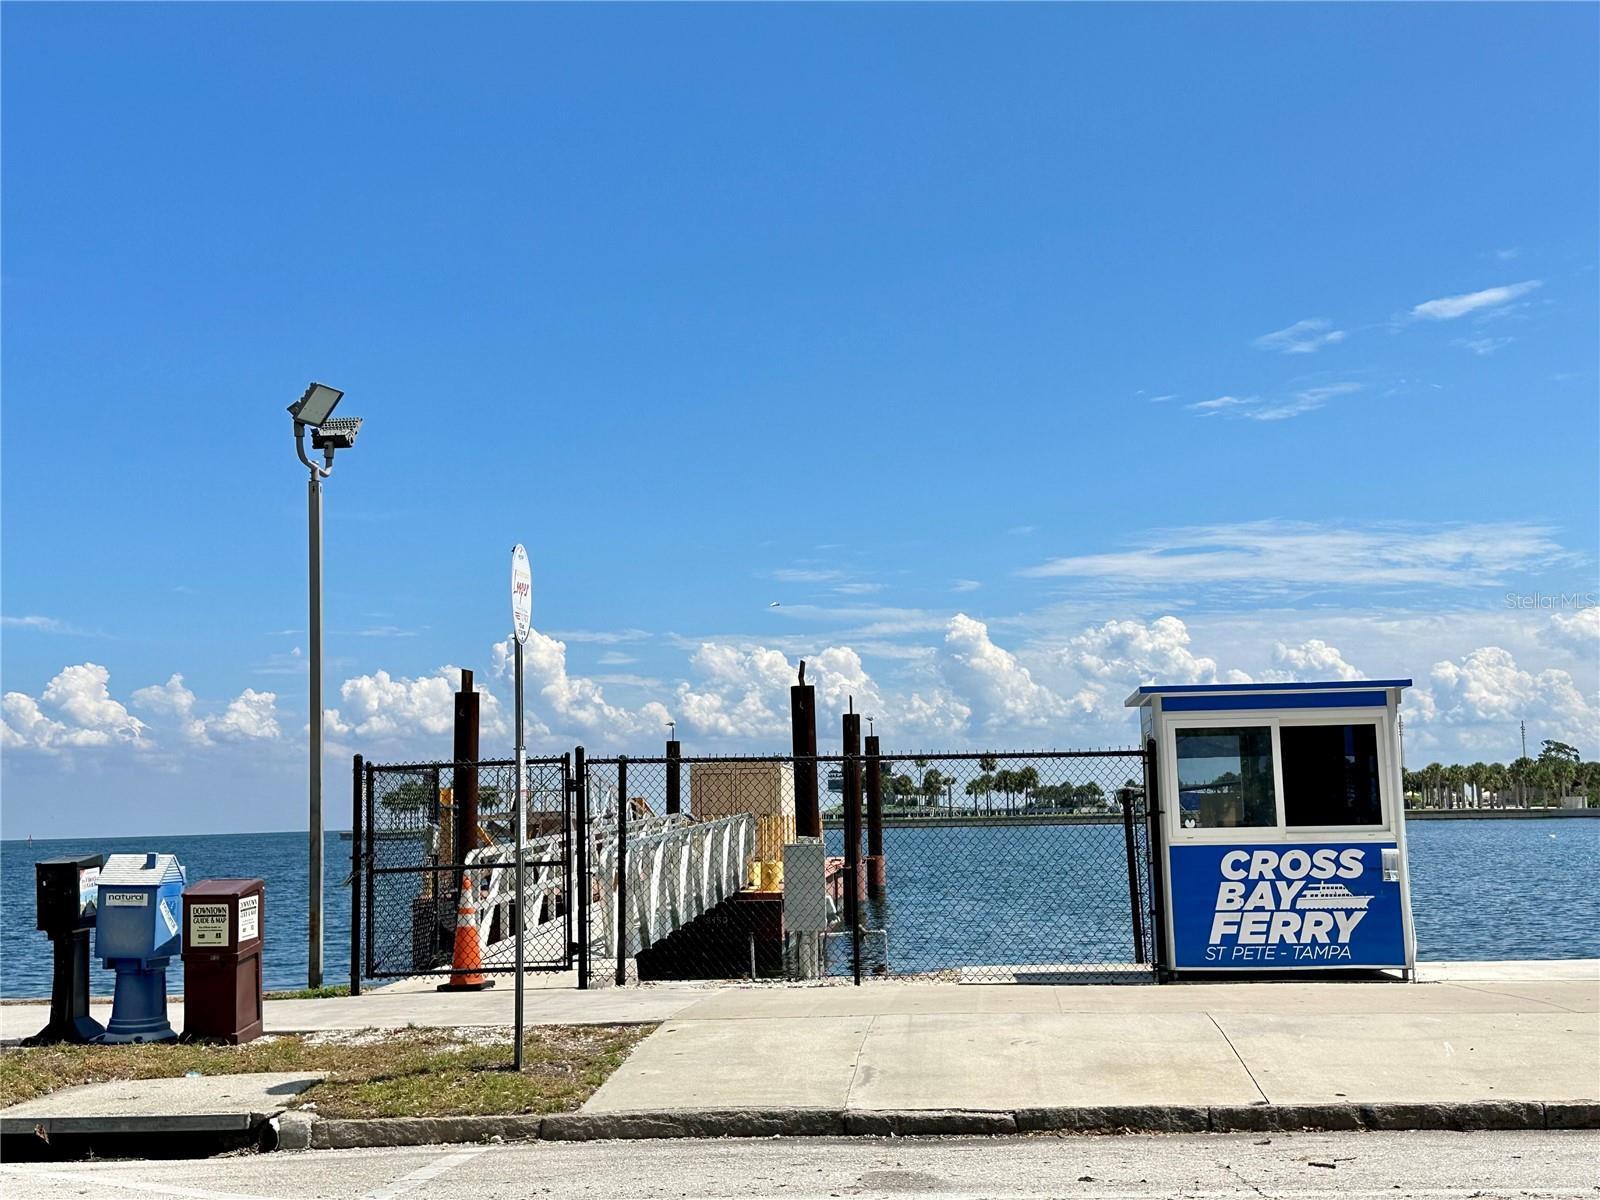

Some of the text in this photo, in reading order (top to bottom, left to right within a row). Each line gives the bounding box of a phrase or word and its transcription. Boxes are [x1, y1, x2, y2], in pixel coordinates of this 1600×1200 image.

[1220, 849, 1366, 880] CROSS
[108, 893, 144, 901] natural
[1215, 881, 1306, 911] BAY
[193, 907, 226, 915] DOWNTOWN
[1208, 911, 1368, 945] FERRY
[1205, 946, 1227, 960] ST
[1231, 946, 1276, 960] PETE
[1294, 945, 1352, 960] TAMPA
